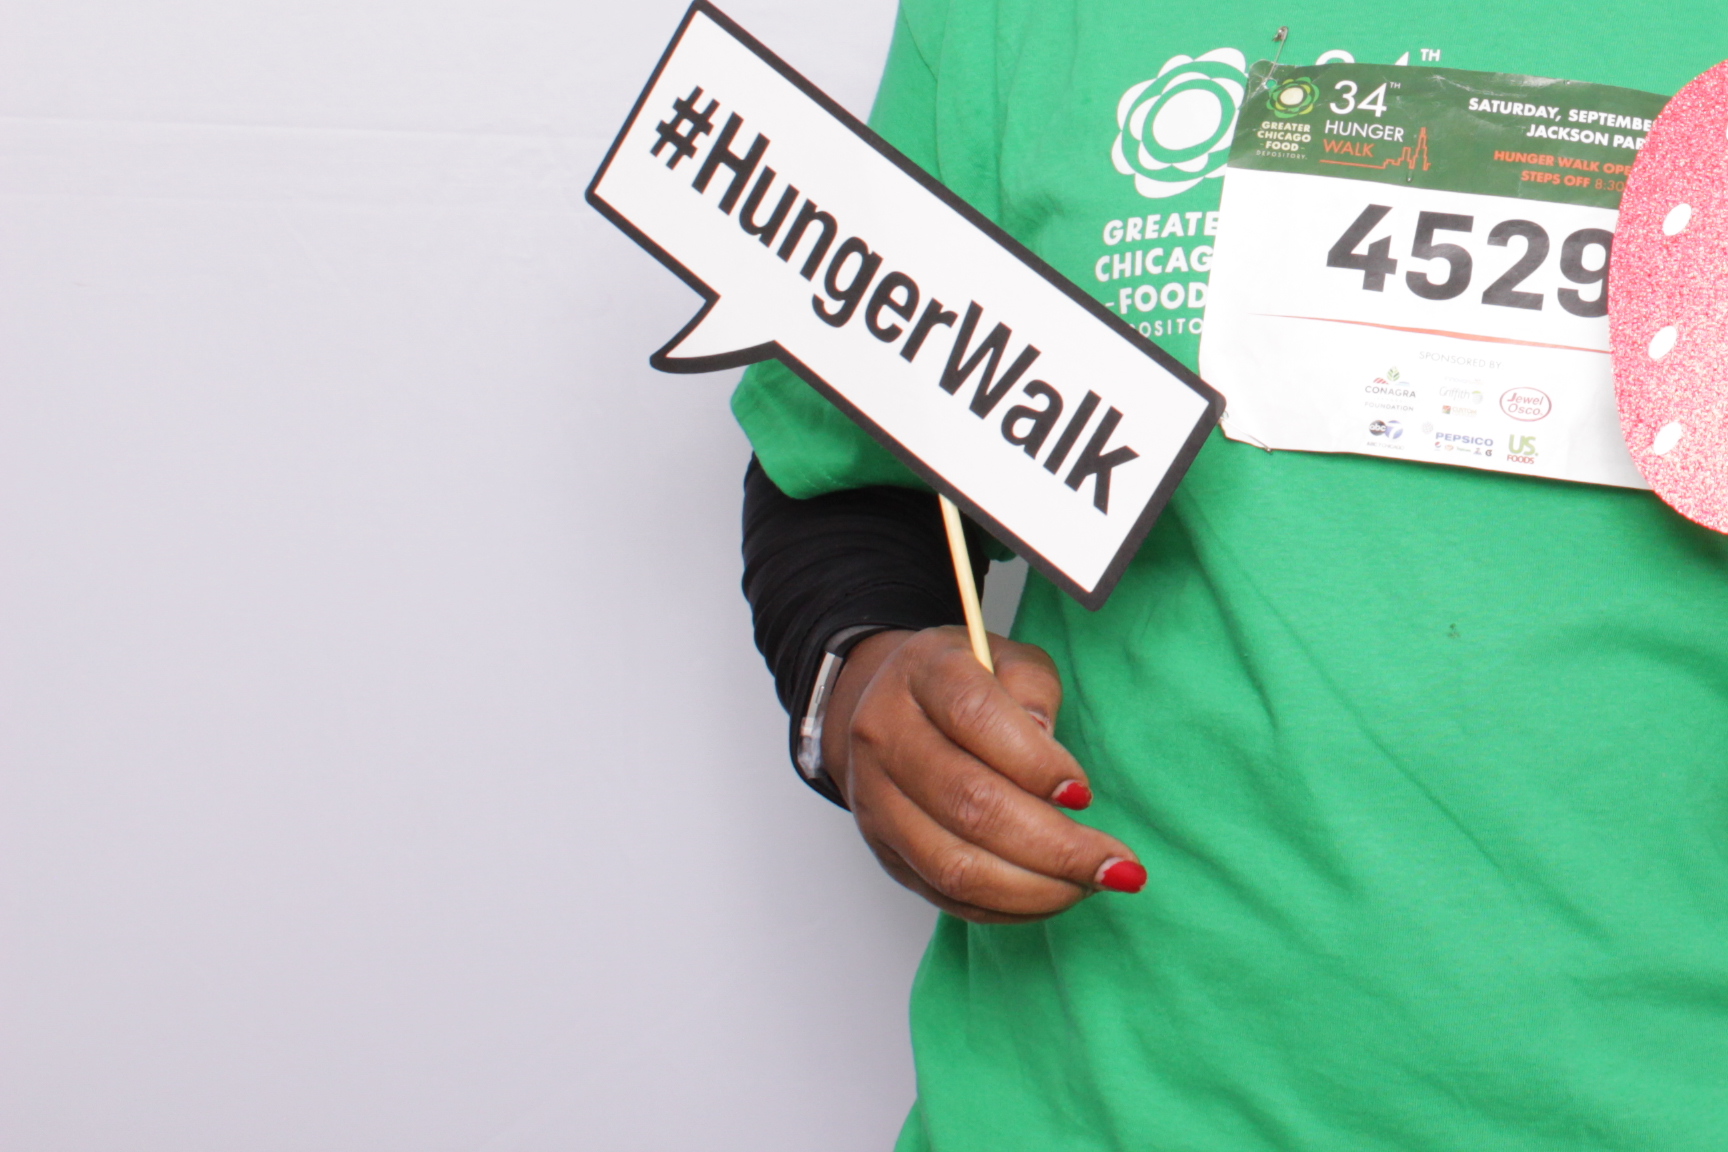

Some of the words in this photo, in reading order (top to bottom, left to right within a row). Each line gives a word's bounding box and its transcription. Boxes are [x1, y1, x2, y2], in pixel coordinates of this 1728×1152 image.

[1468, 97, 1562, 122] SATURDAY,
[1568, 109, 1654, 133] SEPTEMBE
[1257, 130, 1311, 143] CHICAGO
[1261, 121, 1311, 133] GREATER
[1324, 120, 1404, 143] HUNGER
[1526, 124, 1609, 146] JACKSON
[1612, 134, 1646, 151] PAR
[1323, 139, 1375, 158] WALK
[1493, 150, 1555, 166] HUNGER
[1557, 156, 1601, 172] WALK
[1603, 163, 1632, 177] OPE
[1521, 170, 1561, 186] STEPS
[1563, 174, 1591, 188] OFF
[1594, 178, 1625, 192] 8:30
[1103, 211, 1220, 246] GREATE
[1095, 245, 1214, 282] CHICAG
[1326, 203, 1615, 318] 4529
[649, 85, 1140, 515] #HungerWalk
[1130, 317, 1204, 338] OSITO
[1419, 351, 1486, 368] SPONSORED
[1364, 385, 1416, 399] CONAGRA
[1507, 392, 1544, 406] Jewel
[1364, 401, 1414, 412] FOUNDATION
[1435, 431, 1494, 447] PEPSICO
[1507, 454, 1535, 464] FOODS
